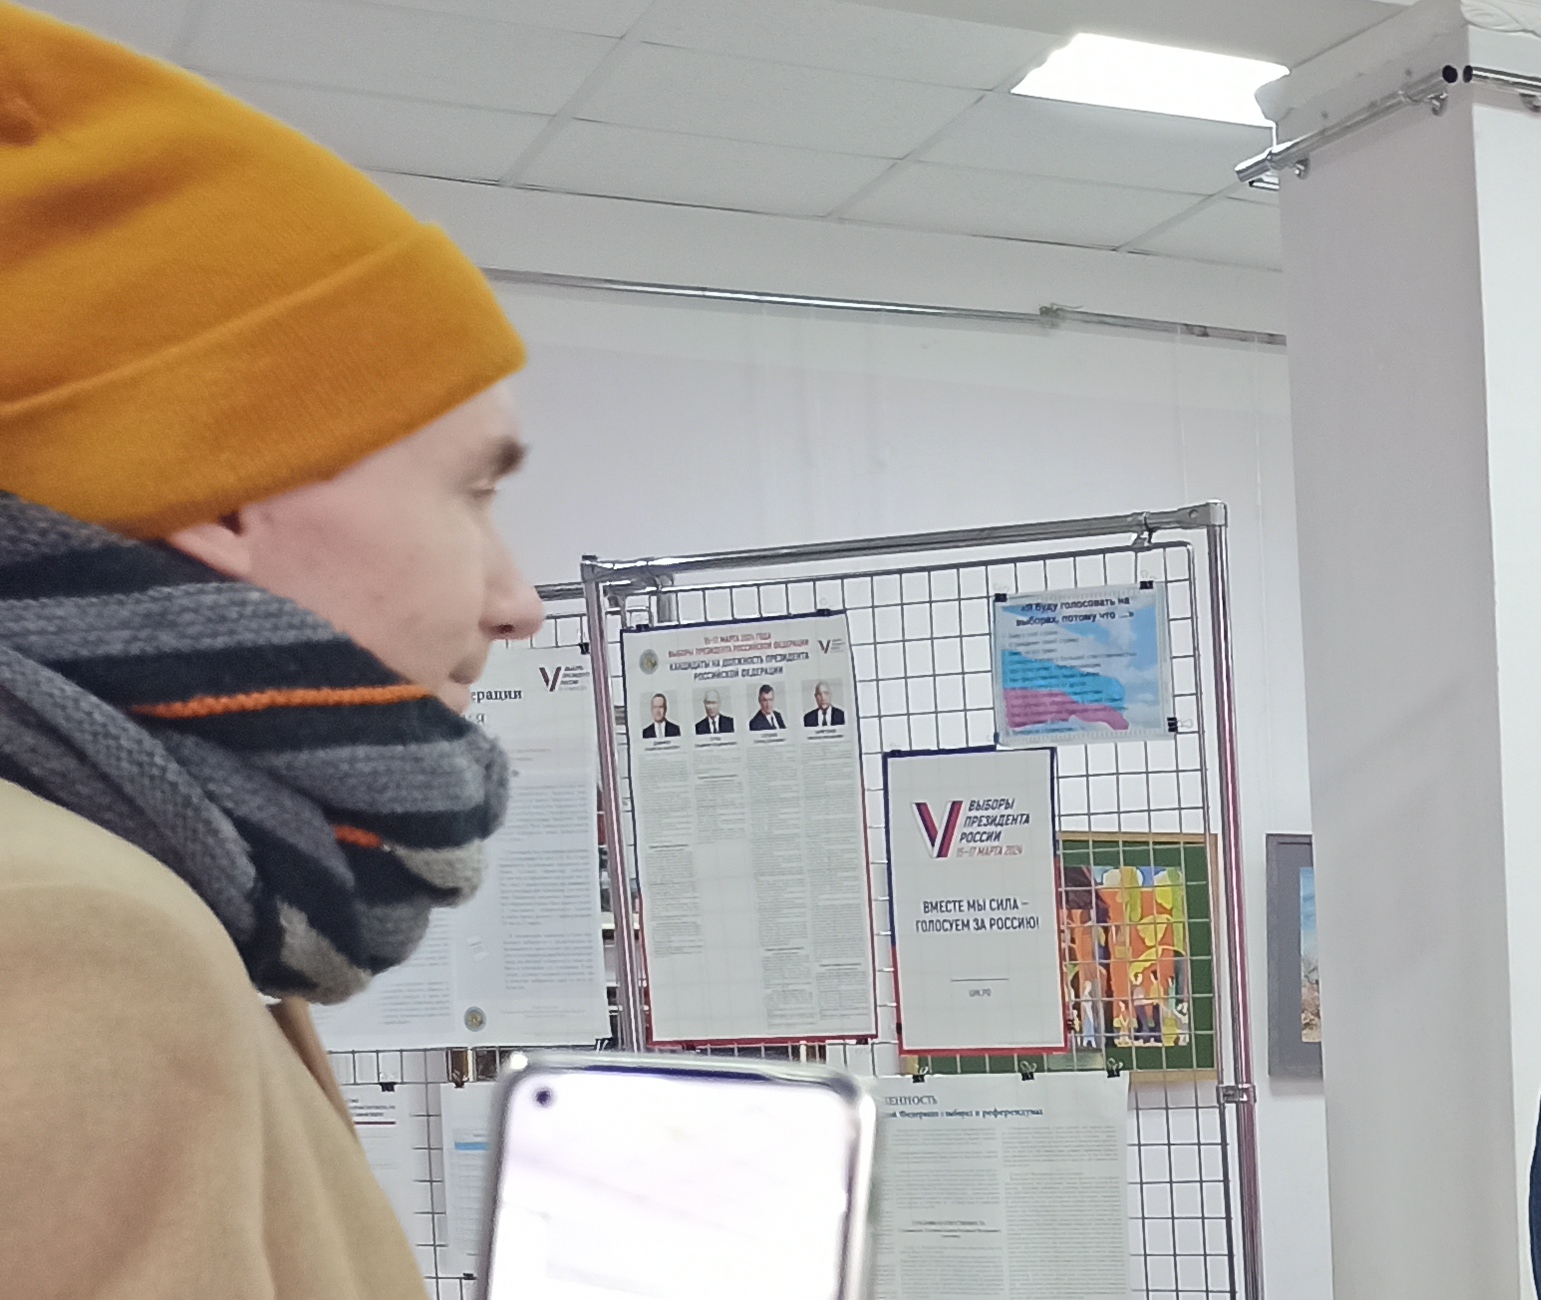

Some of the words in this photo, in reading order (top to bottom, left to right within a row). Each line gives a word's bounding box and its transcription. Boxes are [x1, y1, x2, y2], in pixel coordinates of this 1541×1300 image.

[1034, 602, 1058, 613] буду
[1060, 598, 1115, 609] голосовать
[1117, 597, 1130, 605] на
[1061, 614, 1097, 622] потому
[1099, 611, 1116, 619] что
[968, 798, 1015, 812] ВЫБОРЫ
[963, 813, 1030, 827] ПРЕЗИДЕНТА
[959, 831, 1002, 843] РОССИИ
[978, 845, 1003, 857] МАРТА
[923, 900, 965, 914] ВМЕСТЕ
[967, 899, 986, 912] МЫ
[989, 898, 1019, 911] СИЛА
[915, 918, 970, 933] ГОЛОСУЕМ
[973, 917, 987, 930] ЗА
[989, 916, 1039, 930] РОССИЮ!
